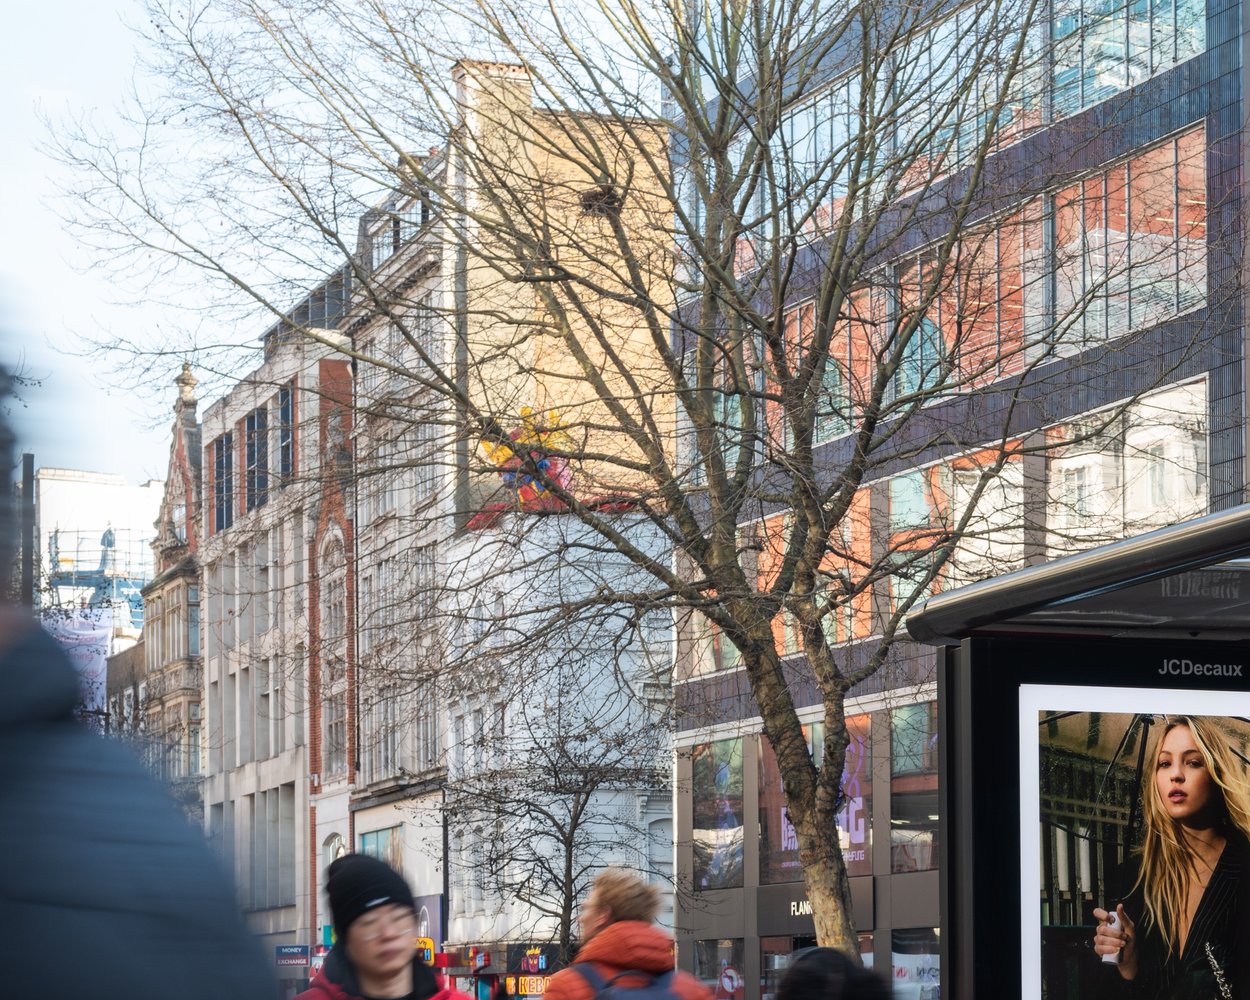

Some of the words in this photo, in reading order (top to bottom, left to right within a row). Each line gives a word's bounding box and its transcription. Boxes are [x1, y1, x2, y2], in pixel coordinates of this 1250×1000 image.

[1158, 659, 1243, 678] JCDecaux
[281, 946, 302, 954] MONEY
[277, 958, 307, 966] EXCHANGE
